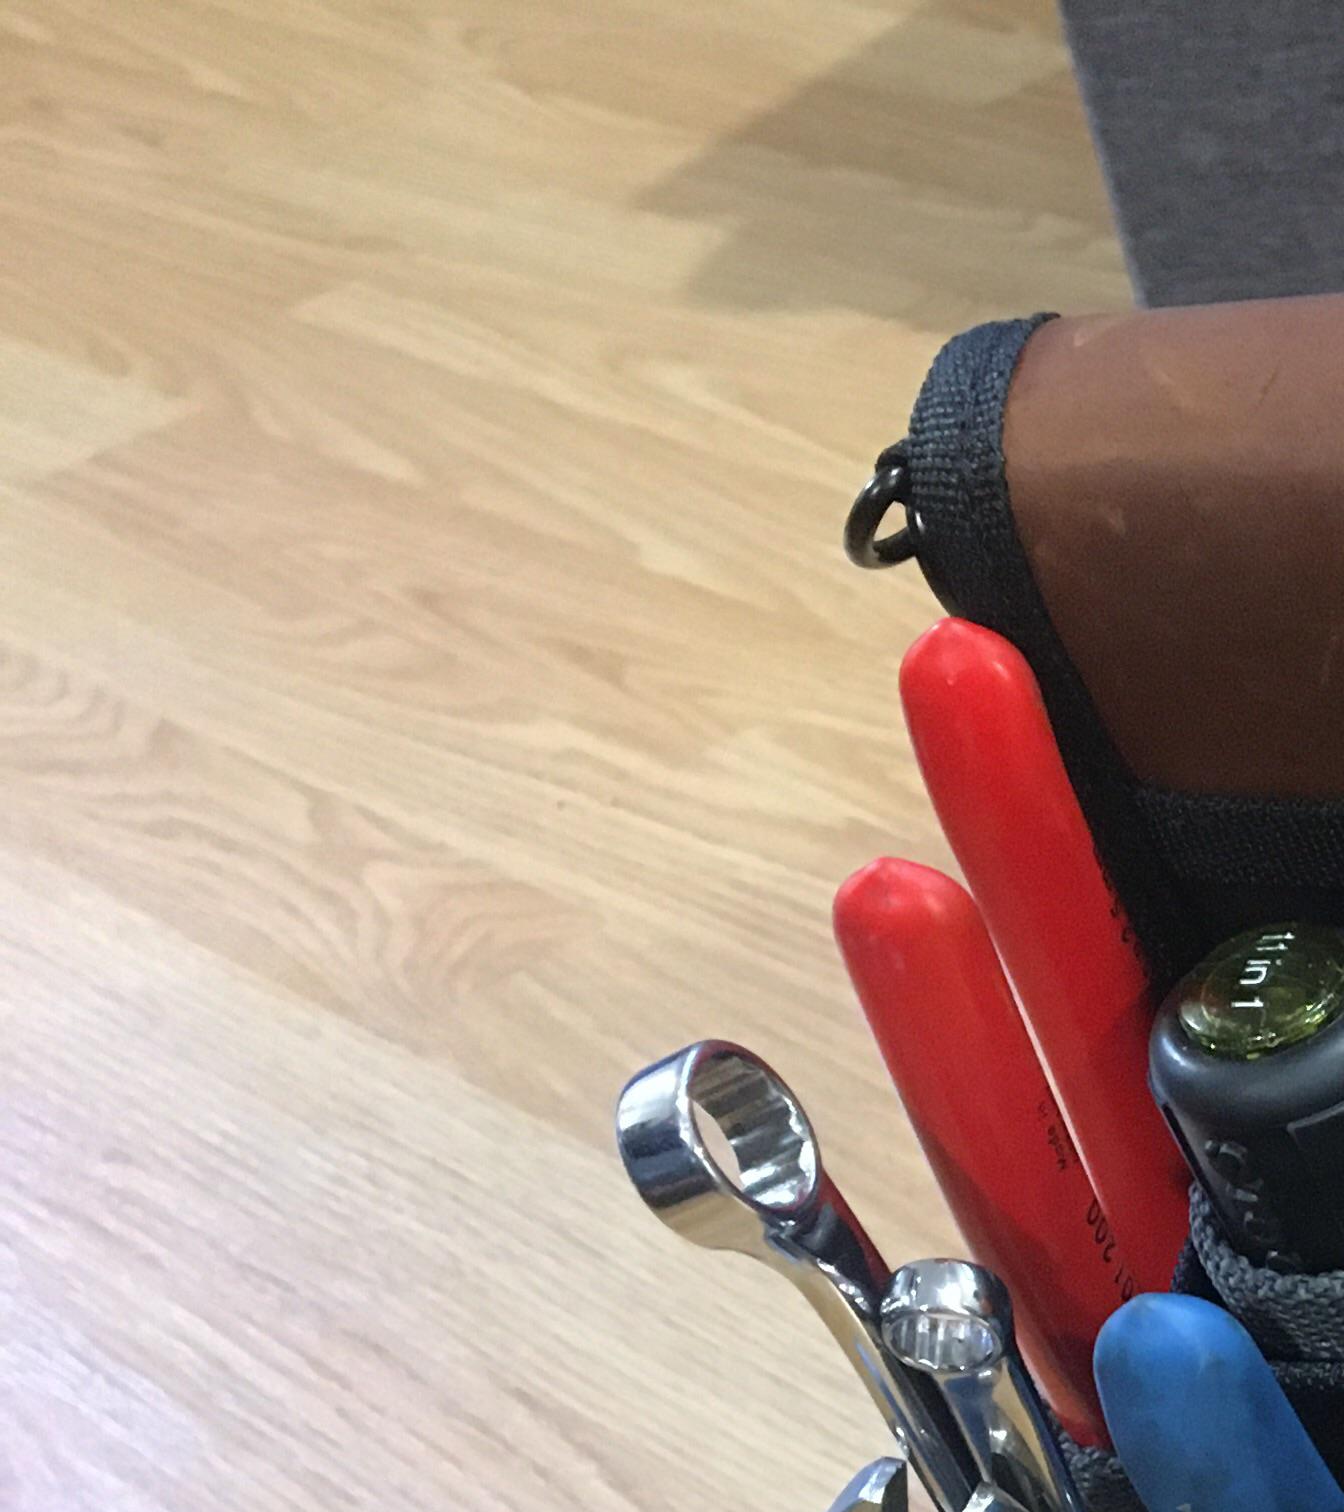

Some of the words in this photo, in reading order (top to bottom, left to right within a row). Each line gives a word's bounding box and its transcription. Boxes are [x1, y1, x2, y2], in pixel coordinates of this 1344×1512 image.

[1256, 931, 1296, 952] 11
[1239, 959, 1283, 986] in
[1230, 996, 1265, 1009] 1
